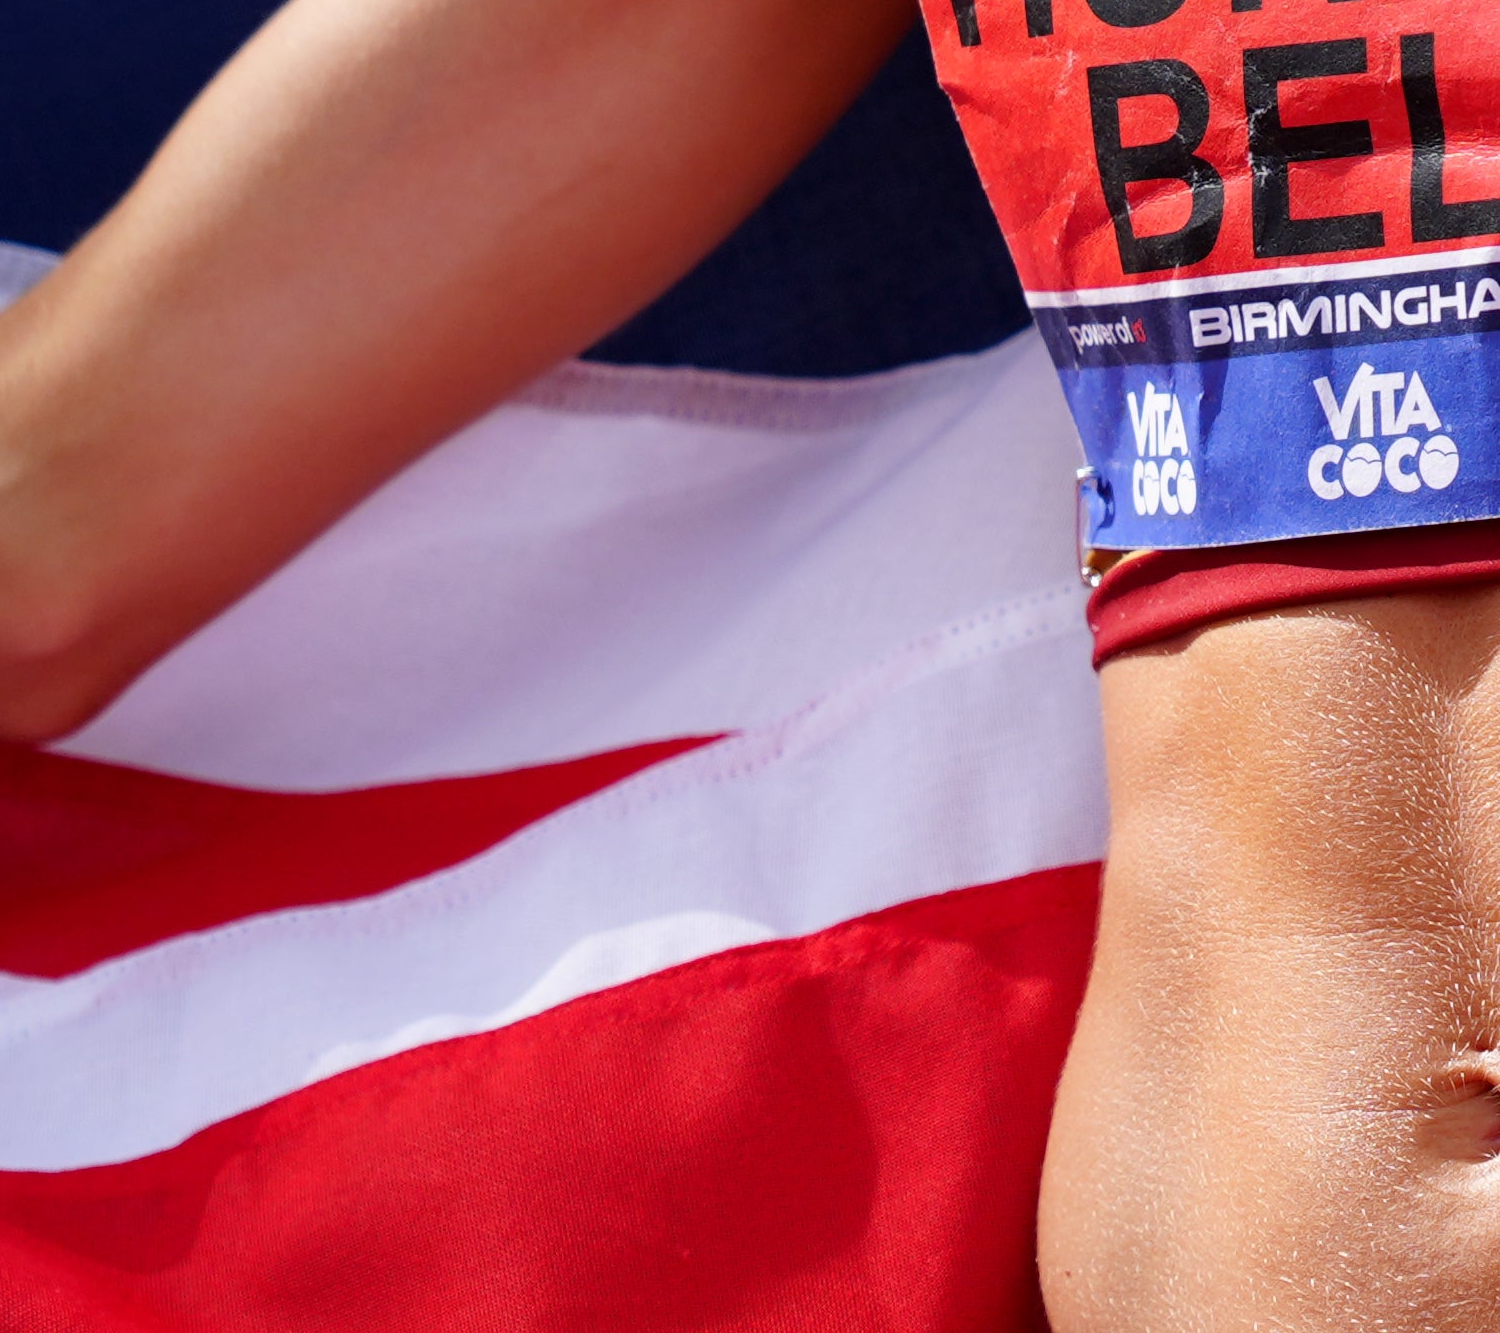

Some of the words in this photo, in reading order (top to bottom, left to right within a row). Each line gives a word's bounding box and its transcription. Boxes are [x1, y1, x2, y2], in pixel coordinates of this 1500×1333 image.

[1067, 322, 1117, 355] power
[1126, 380, 1190, 457] VITA
[1312, 361, 1442, 441] VITA
[1132, 457, 1197, 517] COCO
[1307, 433, 1460, 501] COCO
